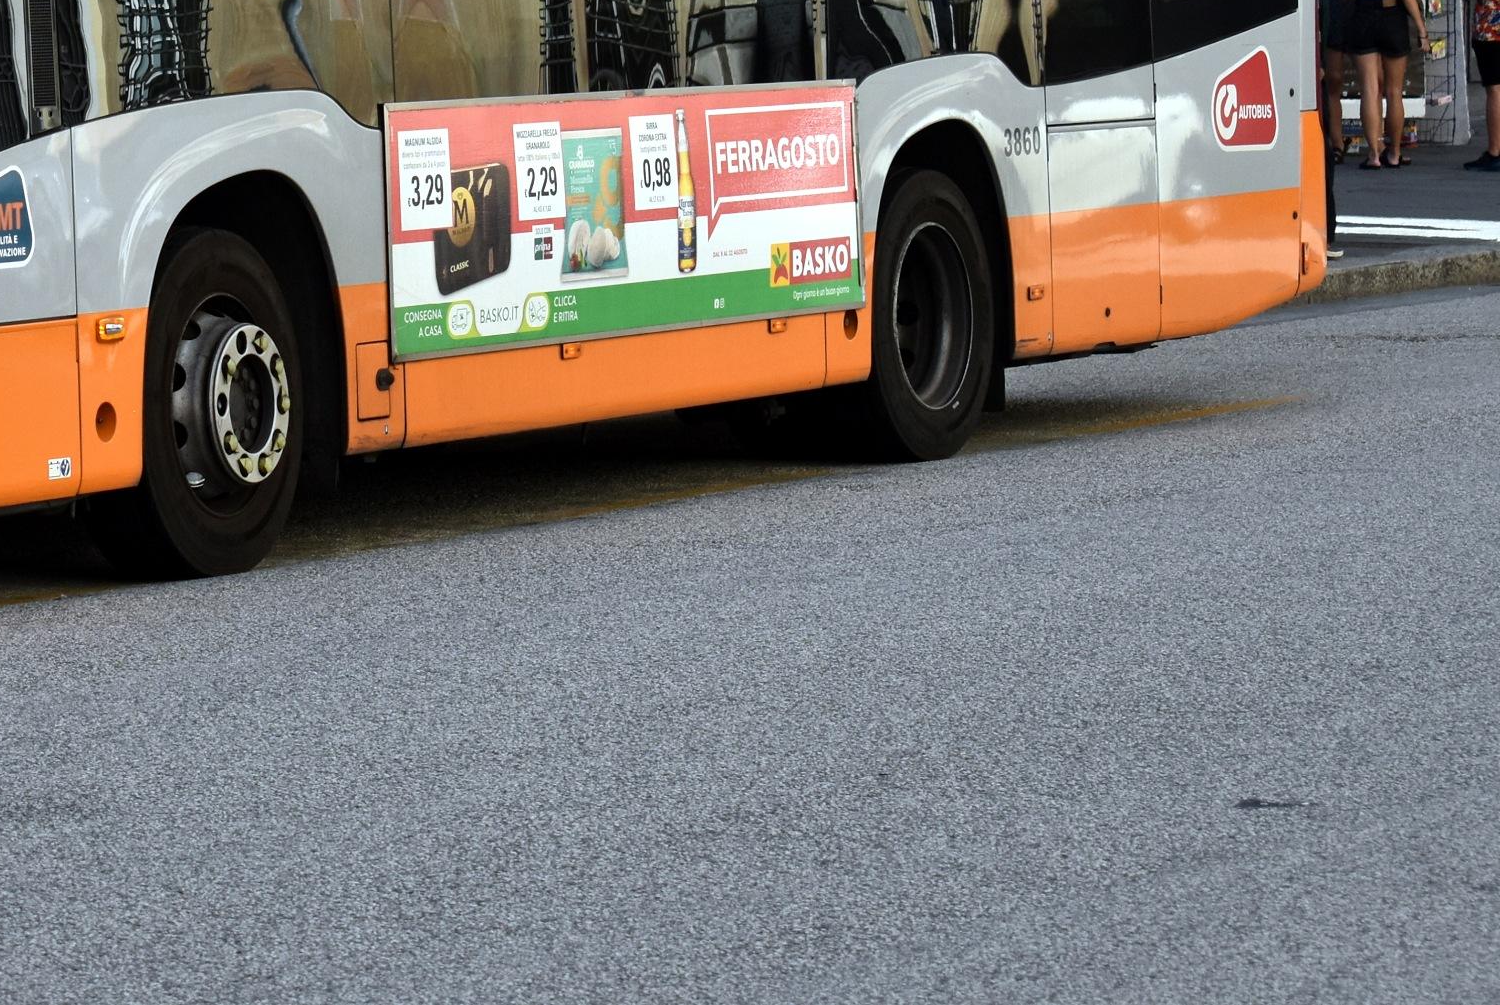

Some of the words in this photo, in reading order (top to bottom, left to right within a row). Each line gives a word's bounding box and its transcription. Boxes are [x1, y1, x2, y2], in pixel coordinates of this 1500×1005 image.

[1238, 103, 1272, 120] AUTOBUS
[516, 129, 542, 139] MOZZARELLA
[542, 128, 558, 137] FRESCA
[638, 134, 655, 142] CORONA
[655, 133, 667, 141] EXTRA
[404, 137, 426, 147] MAGNUM
[426, 136, 443, 146] ALGIDA
[525, 141, 551, 150] GRANAROLO
[1003, 126, 1041, 157] 3860
[715, 133, 840, 174] FERRAGOSTO
[13, 235, 18, 244] E
[449, 259, 470, 274] CLASSIC
[792, 244, 848, 278] BASKO
[553, 295, 577, 307] CLICCA
[404, 308, 443, 323] CONSEGNA
[480, 305, 519, 324] BASKO.IT
[553, 312, 558, 323] E
[558, 309, 579, 322] RITIRA
[418, 328, 424, 338] A
[424, 325, 443, 337] CASA
